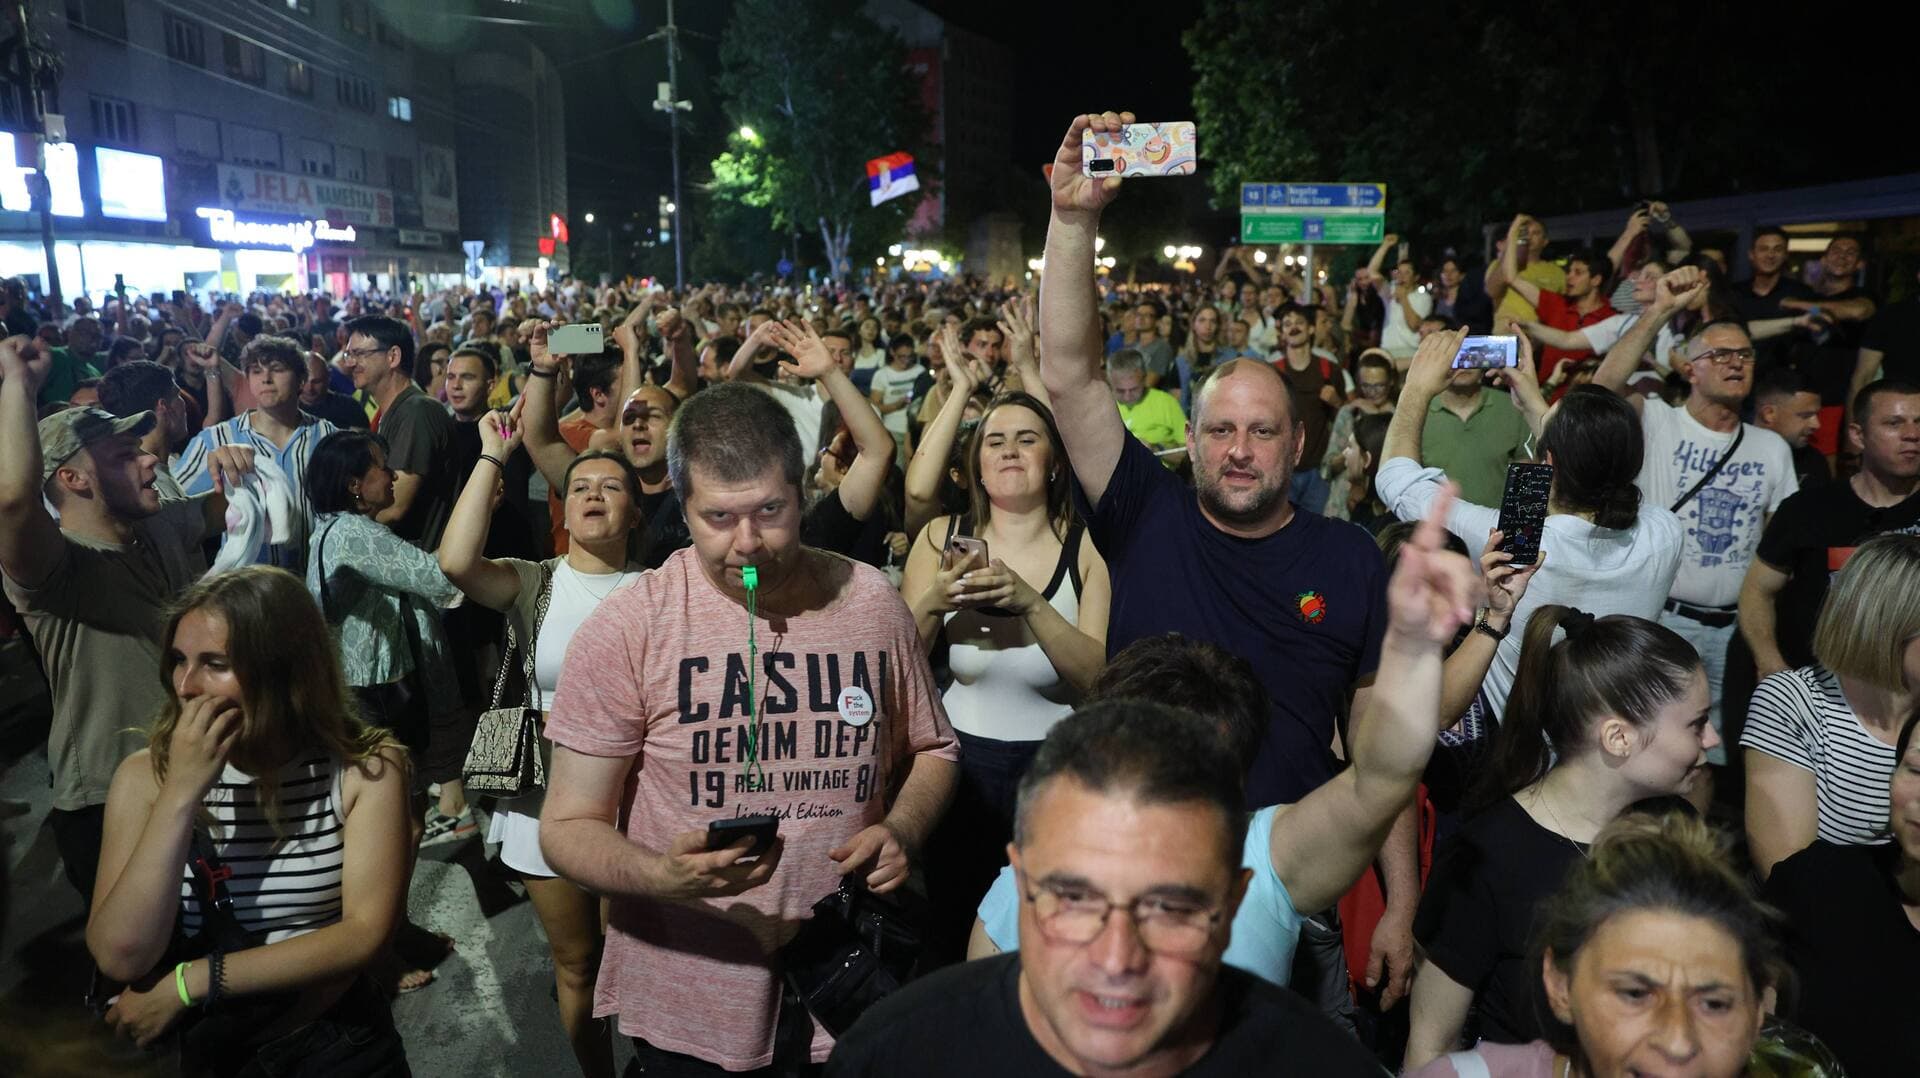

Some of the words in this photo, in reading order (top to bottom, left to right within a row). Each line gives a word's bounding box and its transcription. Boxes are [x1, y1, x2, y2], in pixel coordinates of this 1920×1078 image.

[246, 171, 313, 207] JELA
[845, 695, 863, 709] Fuck
[849, 710, 870, 718] system
[692, 721, 797, 764] DENIM
[690, 770, 725, 808] 19
[735, 772, 775, 793] REAL
[783, 769, 850, 791] VINTAGE
[735, 803, 792, 820] Limited
[796, 802, 844, 820] Edition
